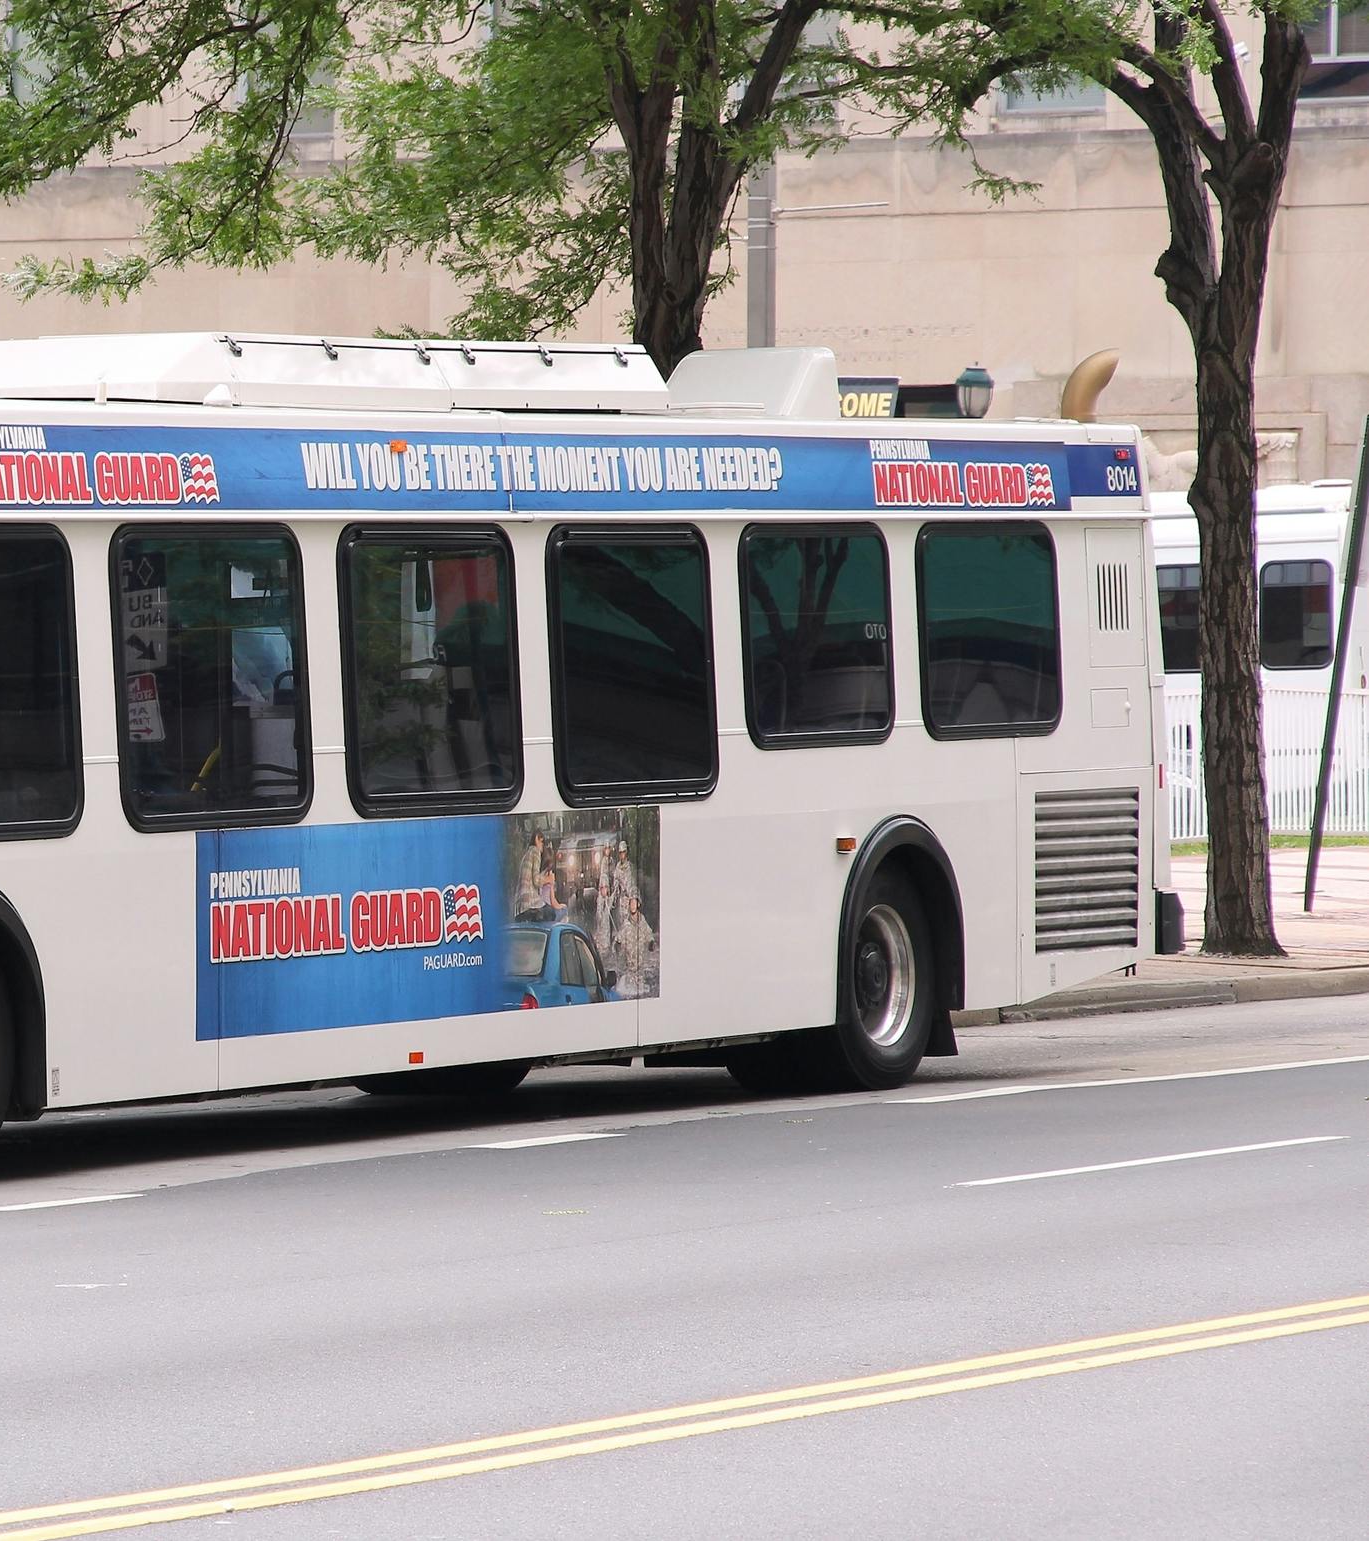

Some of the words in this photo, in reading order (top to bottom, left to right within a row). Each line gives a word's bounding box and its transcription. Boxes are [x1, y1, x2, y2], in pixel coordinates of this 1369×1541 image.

[300, 442, 357, 490] WILL
[355, 442, 401, 491] YOU
[403, 444, 432, 490] BE
[431, 445, 497, 491] THERE
[497, 445, 536, 491] THE
[537, 446, 621, 492] MOMENT
[621, 446, 663, 492] YOU
[665, 447, 702, 491] ARE
[702, 446, 783, 491] NEEDED?
[869, 439, 931, 460] PENNSYLVANIA
[95, 452, 182, 505] GUARD
[872, 461, 964, 507] NATIONAL
[964, 462, 1028, 507] GUARD
[1106, 465, 1138, 492] 8014
[210, 868, 301, 899] PENNSYLVANIA
[210, 893, 347, 963] NATIONAL
[350, 886, 444, 953] GUARD
[423, 952, 483, 970] PAGUARD.com
